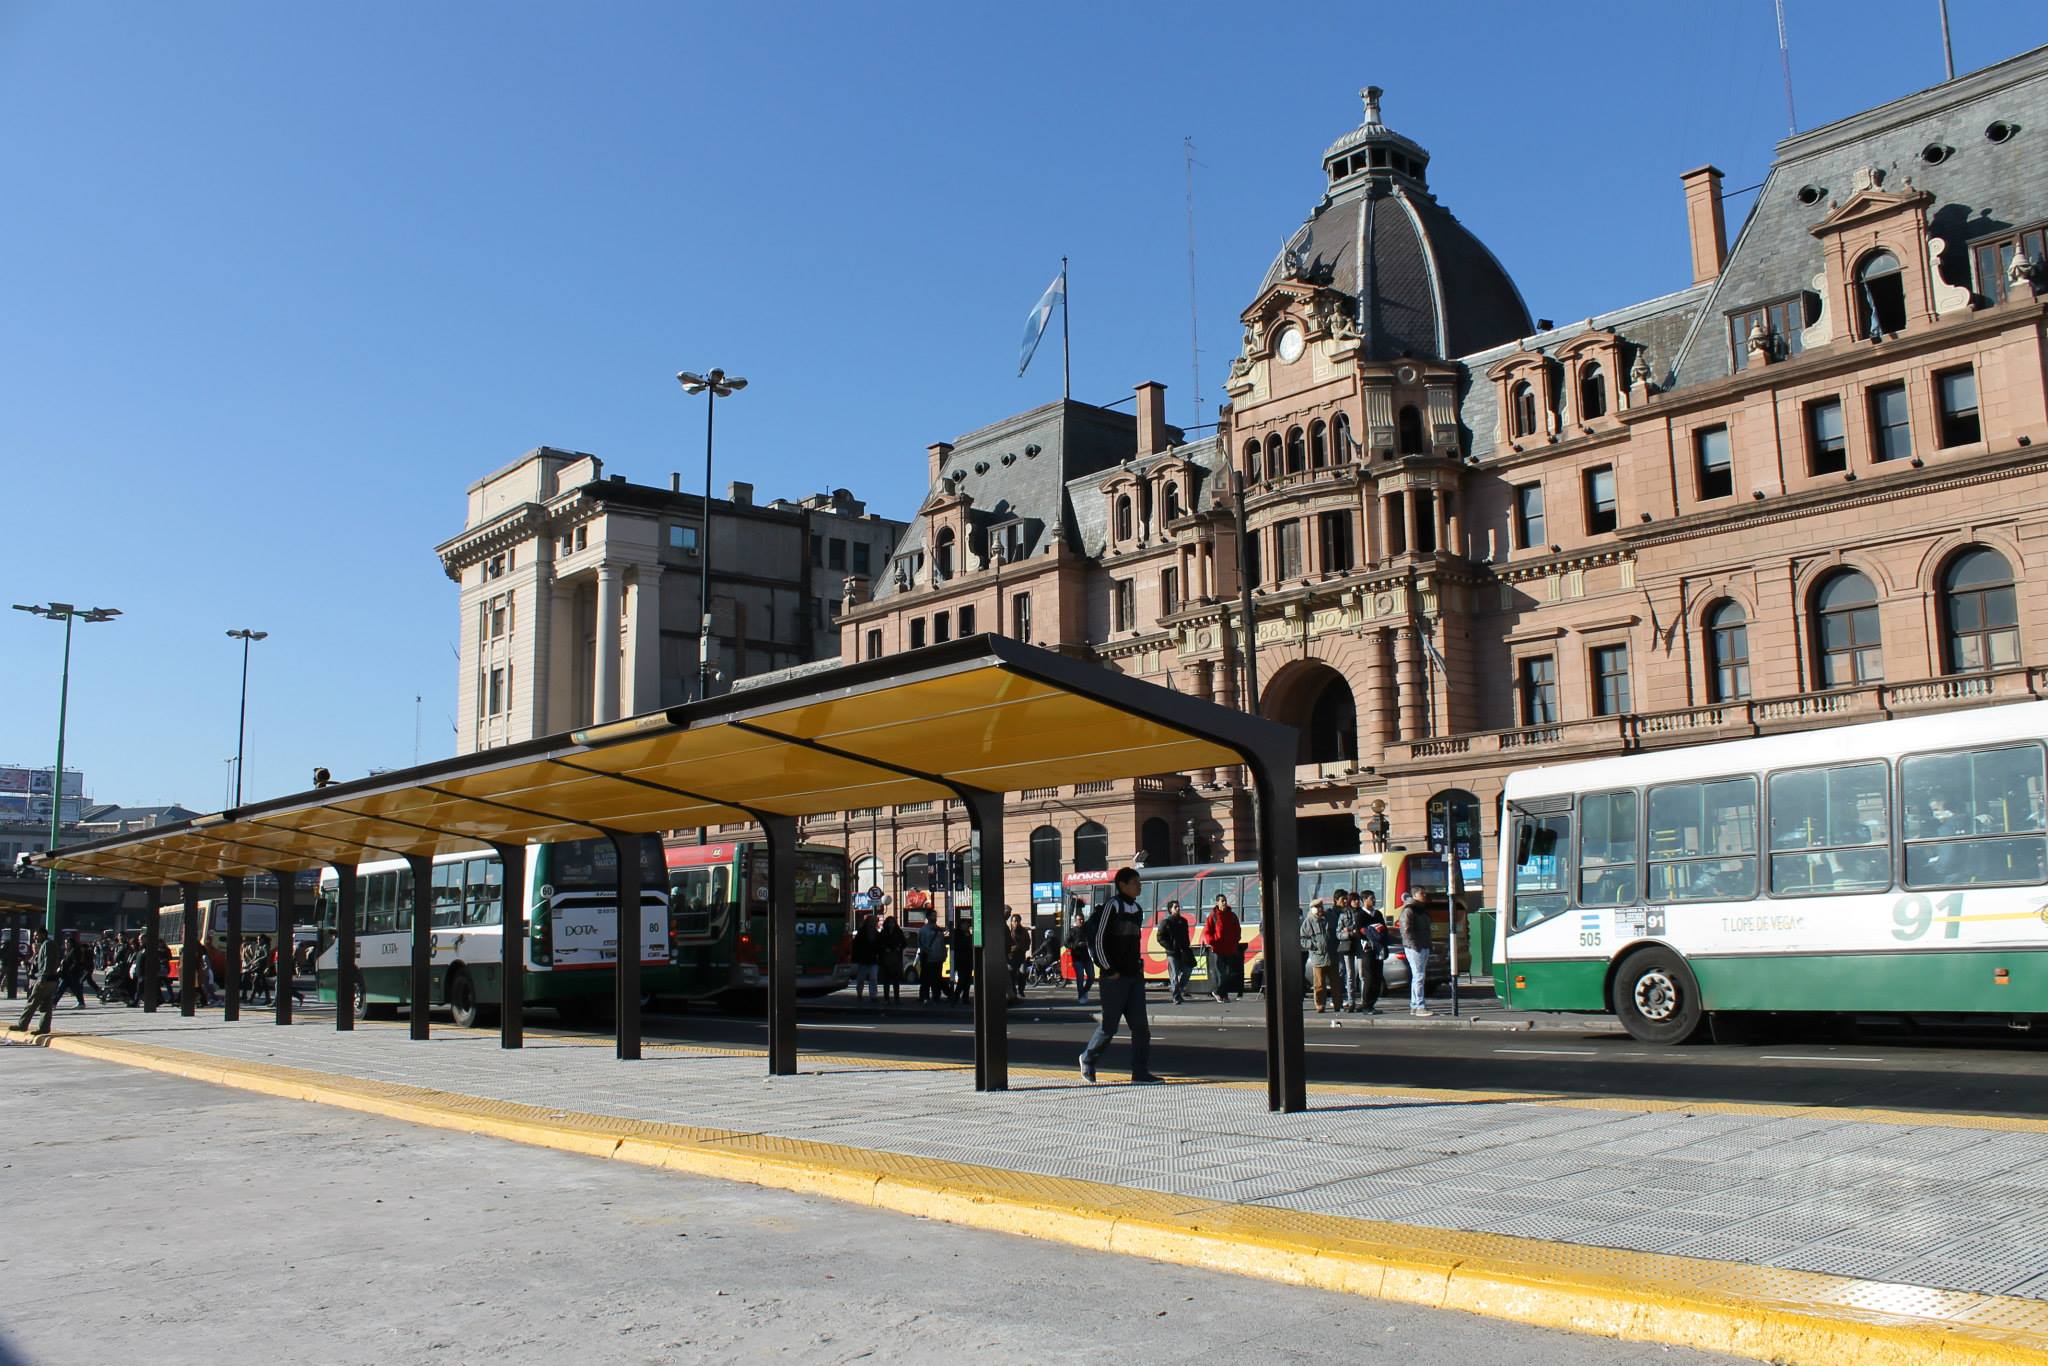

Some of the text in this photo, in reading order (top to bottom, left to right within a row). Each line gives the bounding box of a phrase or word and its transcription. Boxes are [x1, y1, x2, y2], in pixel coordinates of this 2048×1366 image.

[1067, 871, 1109, 881] MONSA
[1647, 915, 1664, 928] 91
[1891, 893, 1964, 941] 91
[1580, 932, 1601, 947] 505
